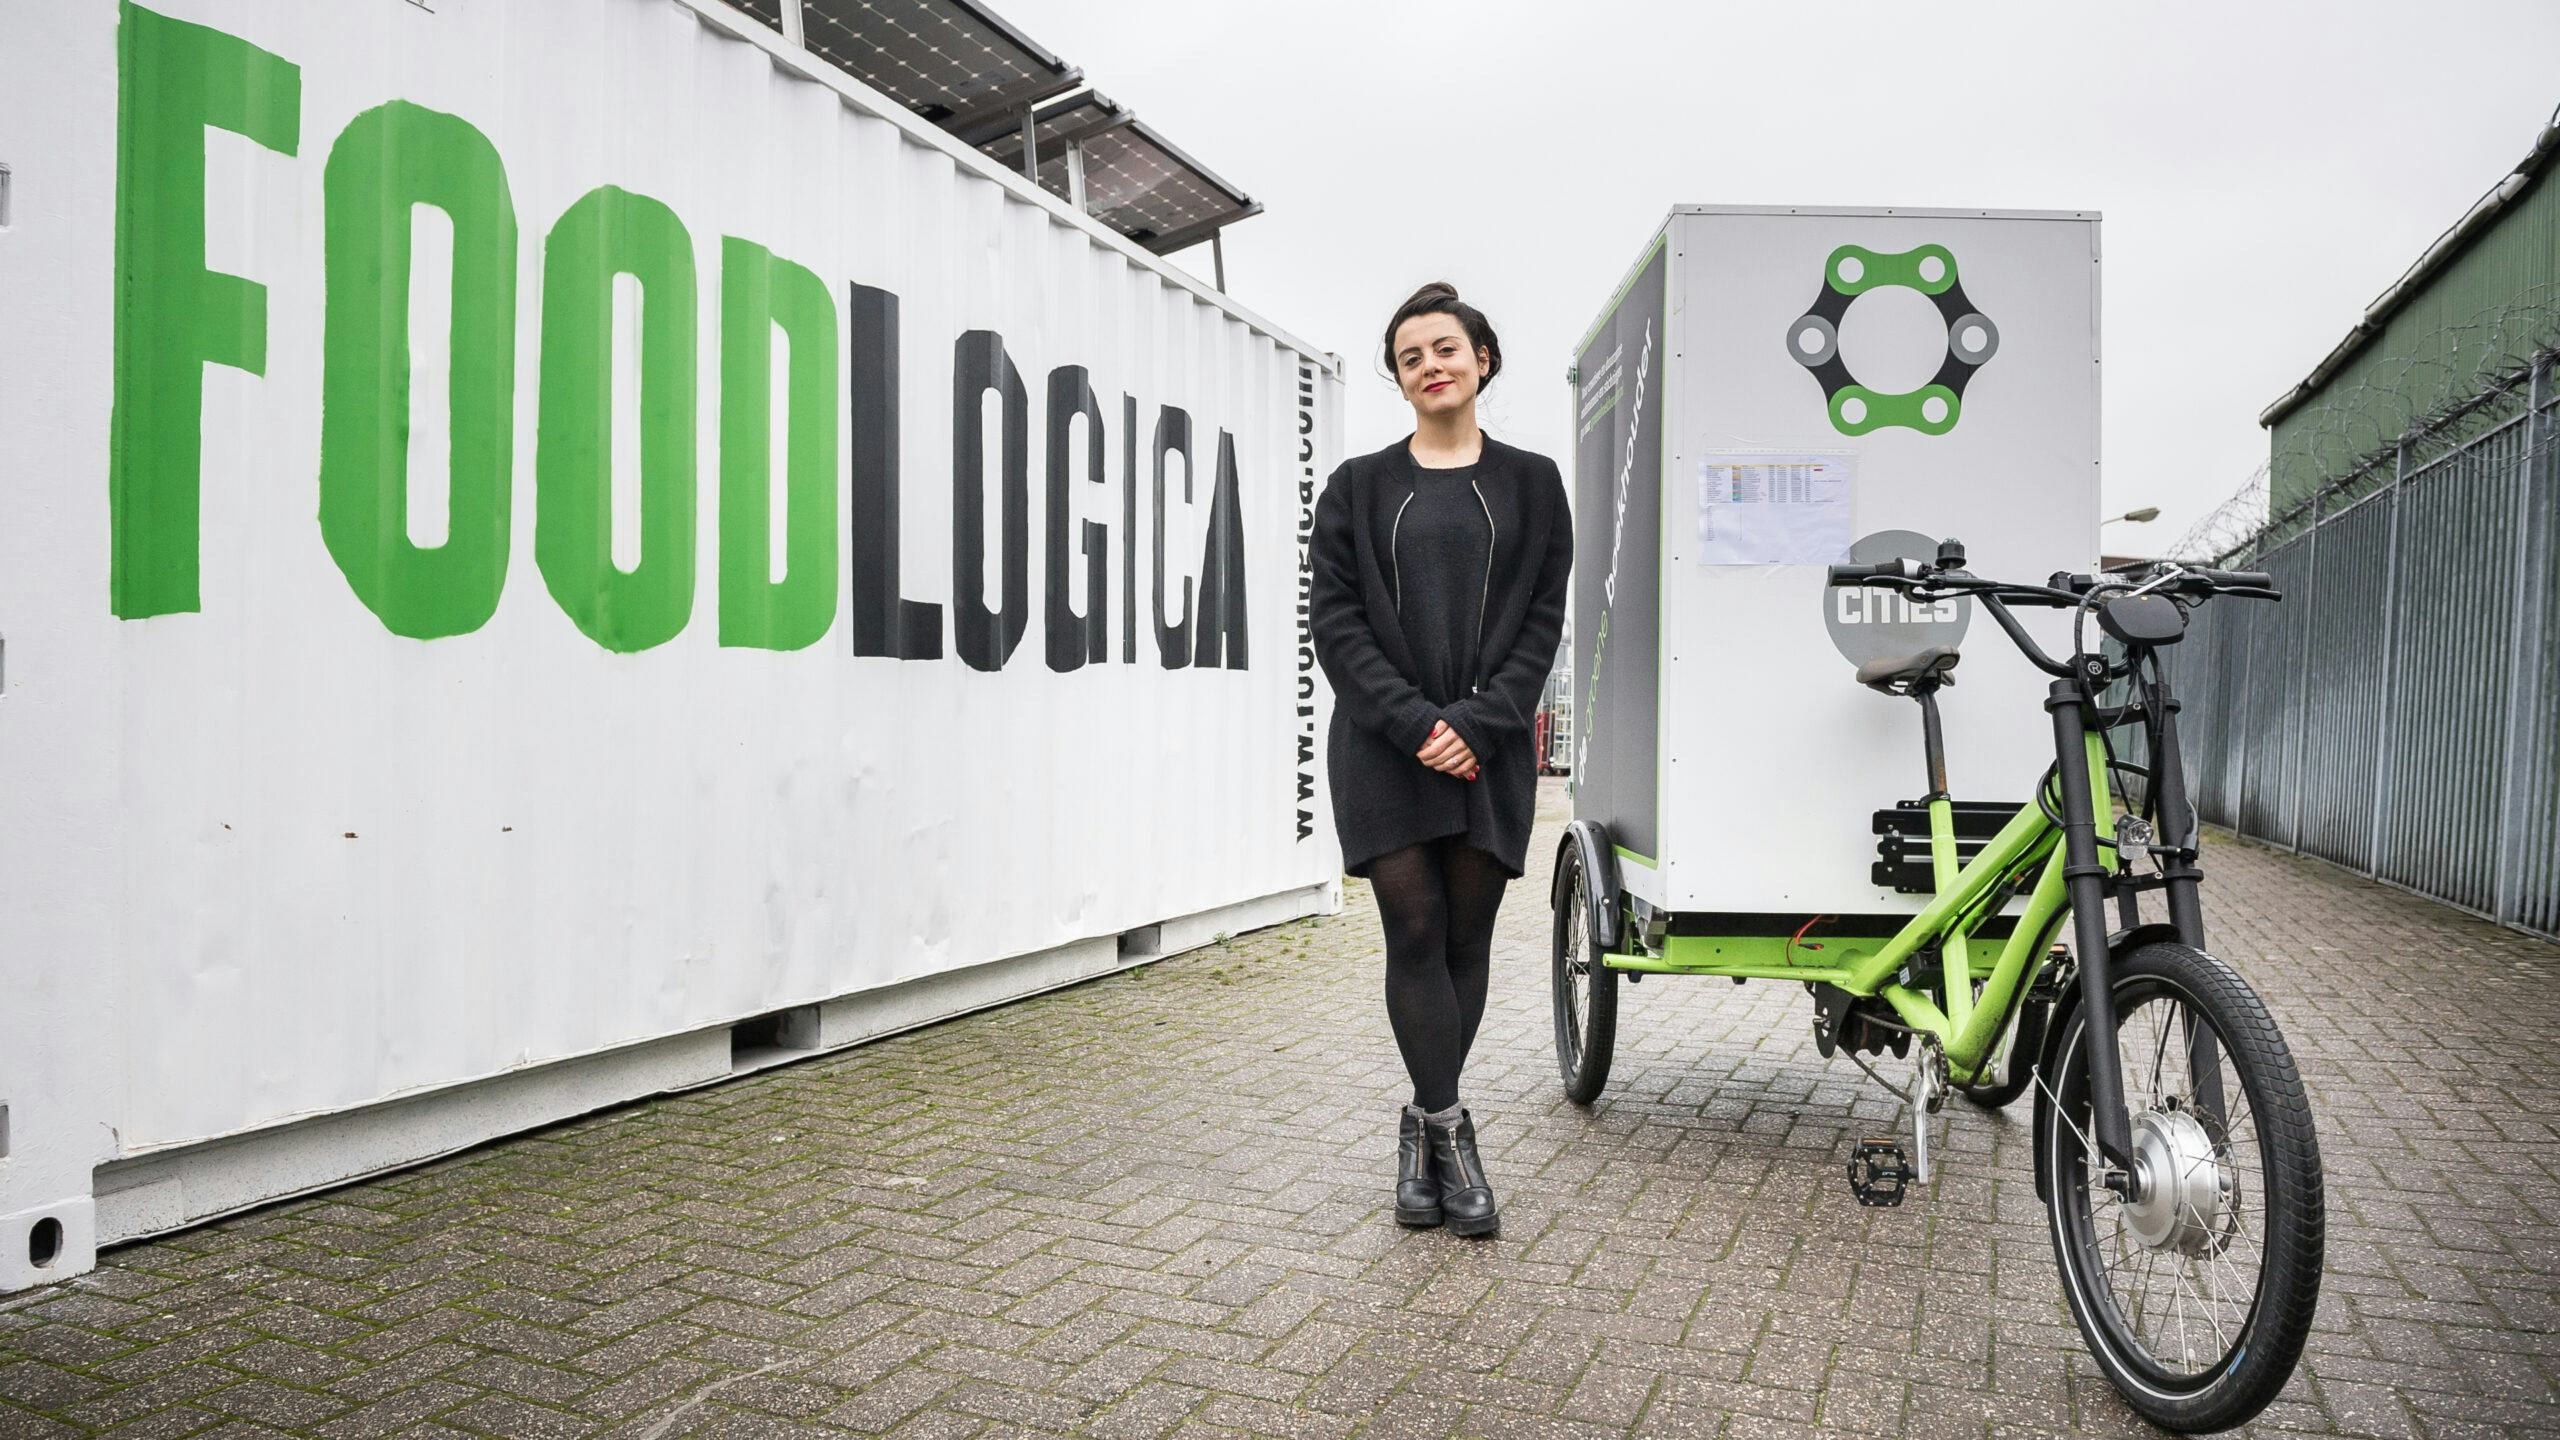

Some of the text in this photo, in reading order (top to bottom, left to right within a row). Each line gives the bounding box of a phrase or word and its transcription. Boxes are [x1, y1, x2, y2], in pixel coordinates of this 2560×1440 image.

[109, 1, 1251, 672] FOODLOGICA
[1578, 317, 1652, 786] de groene boekhouder
[1837, 586, 1958, 624] CITIES
